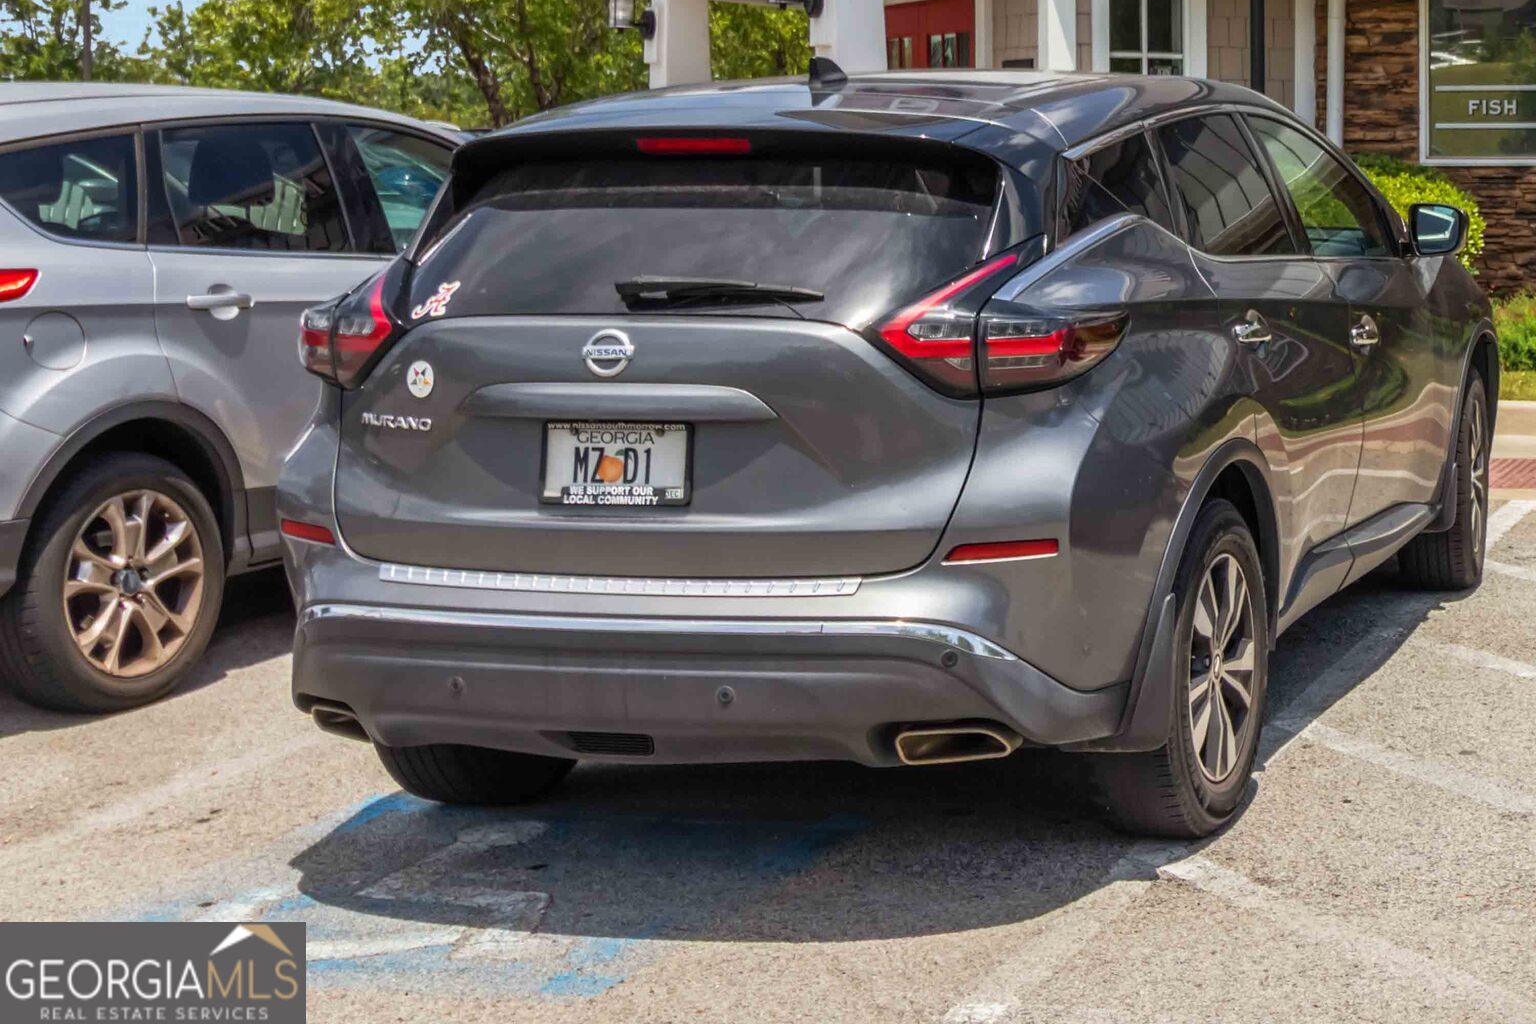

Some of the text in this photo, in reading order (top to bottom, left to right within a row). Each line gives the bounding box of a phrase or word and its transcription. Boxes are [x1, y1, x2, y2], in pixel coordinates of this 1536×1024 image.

[1468, 99, 1518, 116] FISH
[586, 347, 628, 358] NISSAN
[361, 411, 432, 431] MURANO
[576, 430, 656, 445] GEORGIA
[569, 486, 654, 496] WE SUPPORT OUR
[563, 495, 659, 505] LOCAL COMMUNITY
